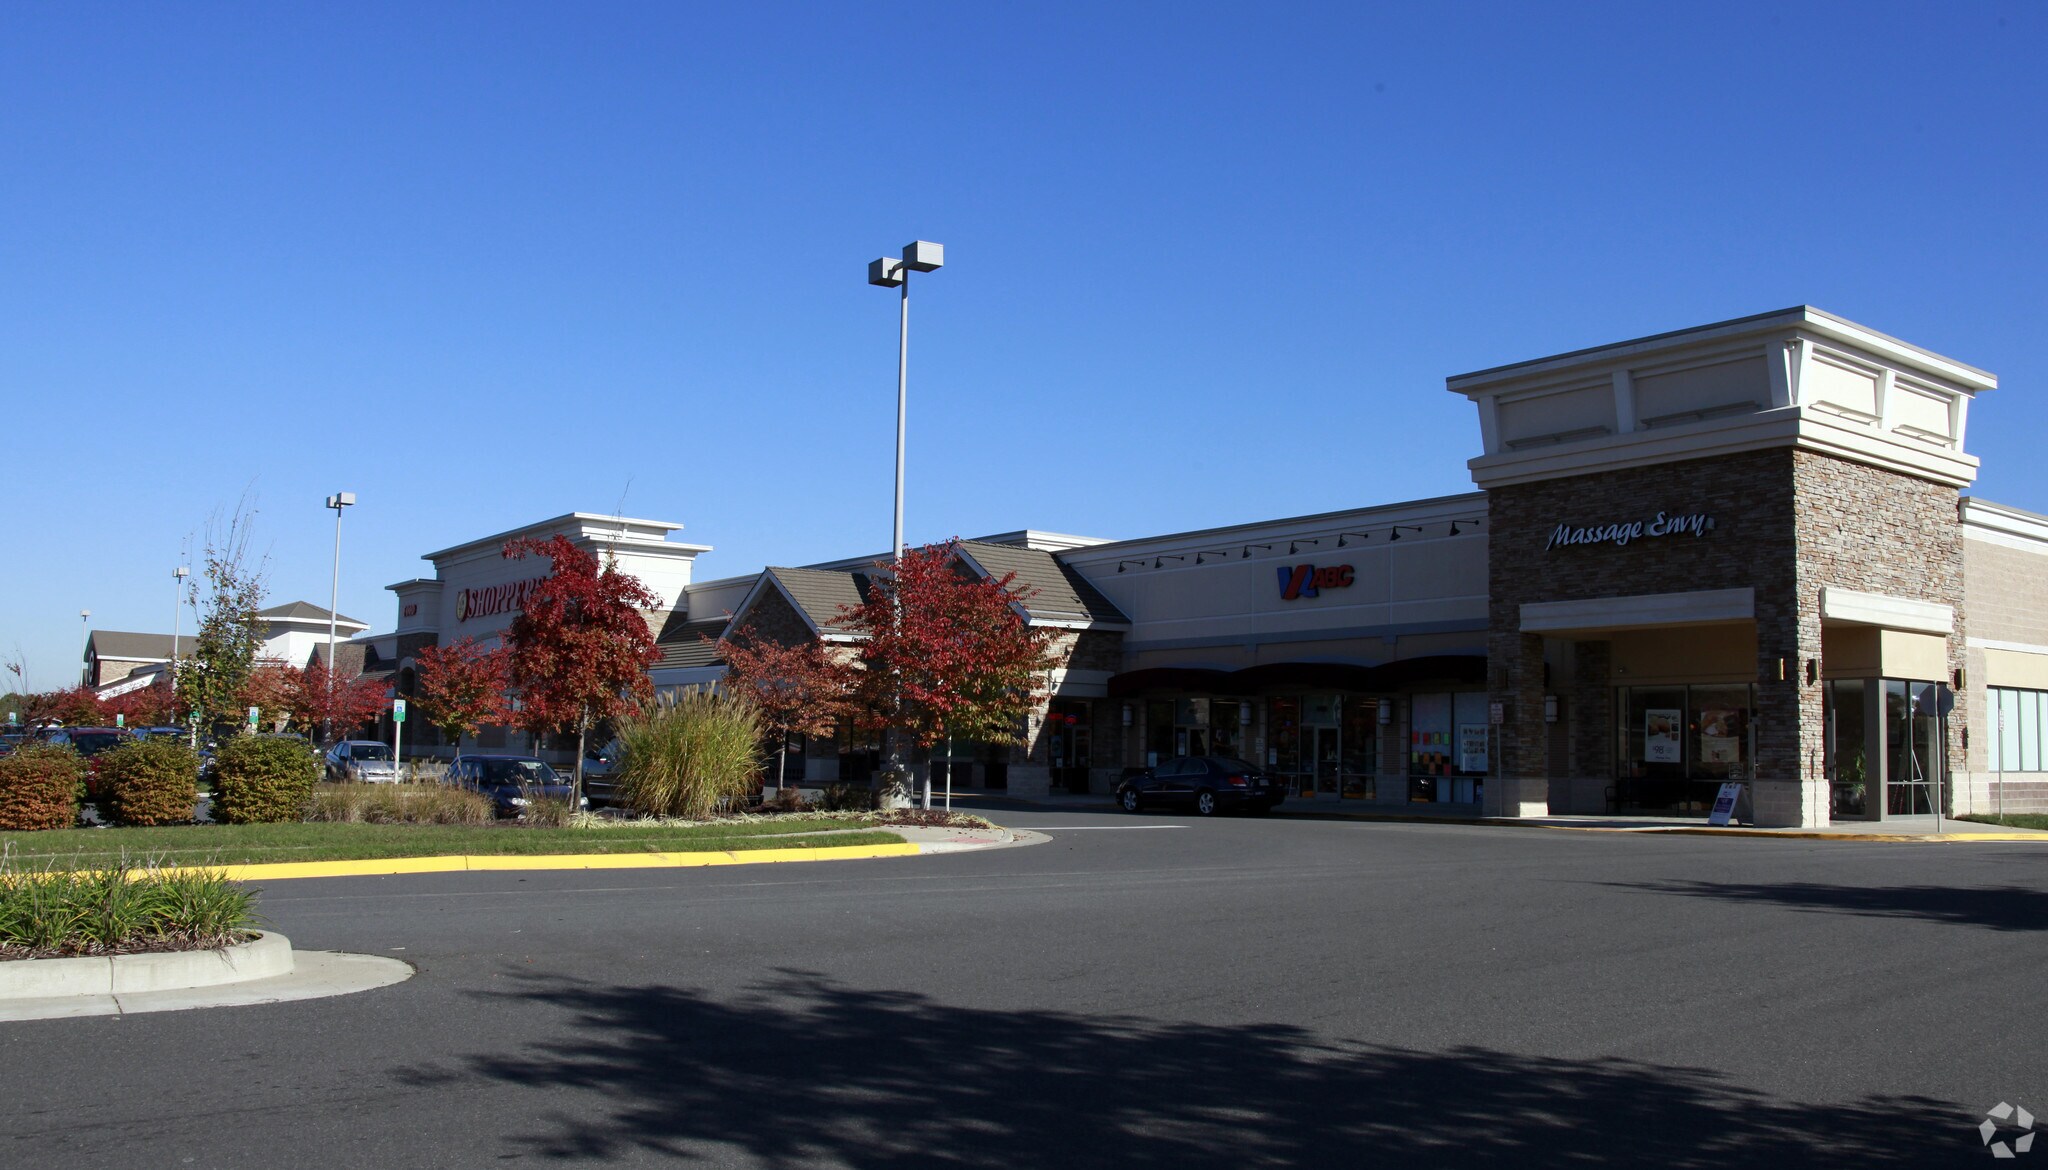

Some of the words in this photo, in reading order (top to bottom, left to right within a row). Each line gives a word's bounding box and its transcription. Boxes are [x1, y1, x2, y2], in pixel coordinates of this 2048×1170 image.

[1545, 521, 1642, 551] Massage
[1649, 511, 1706, 537] Envy
[1309, 564, 1355, 589] ABC
